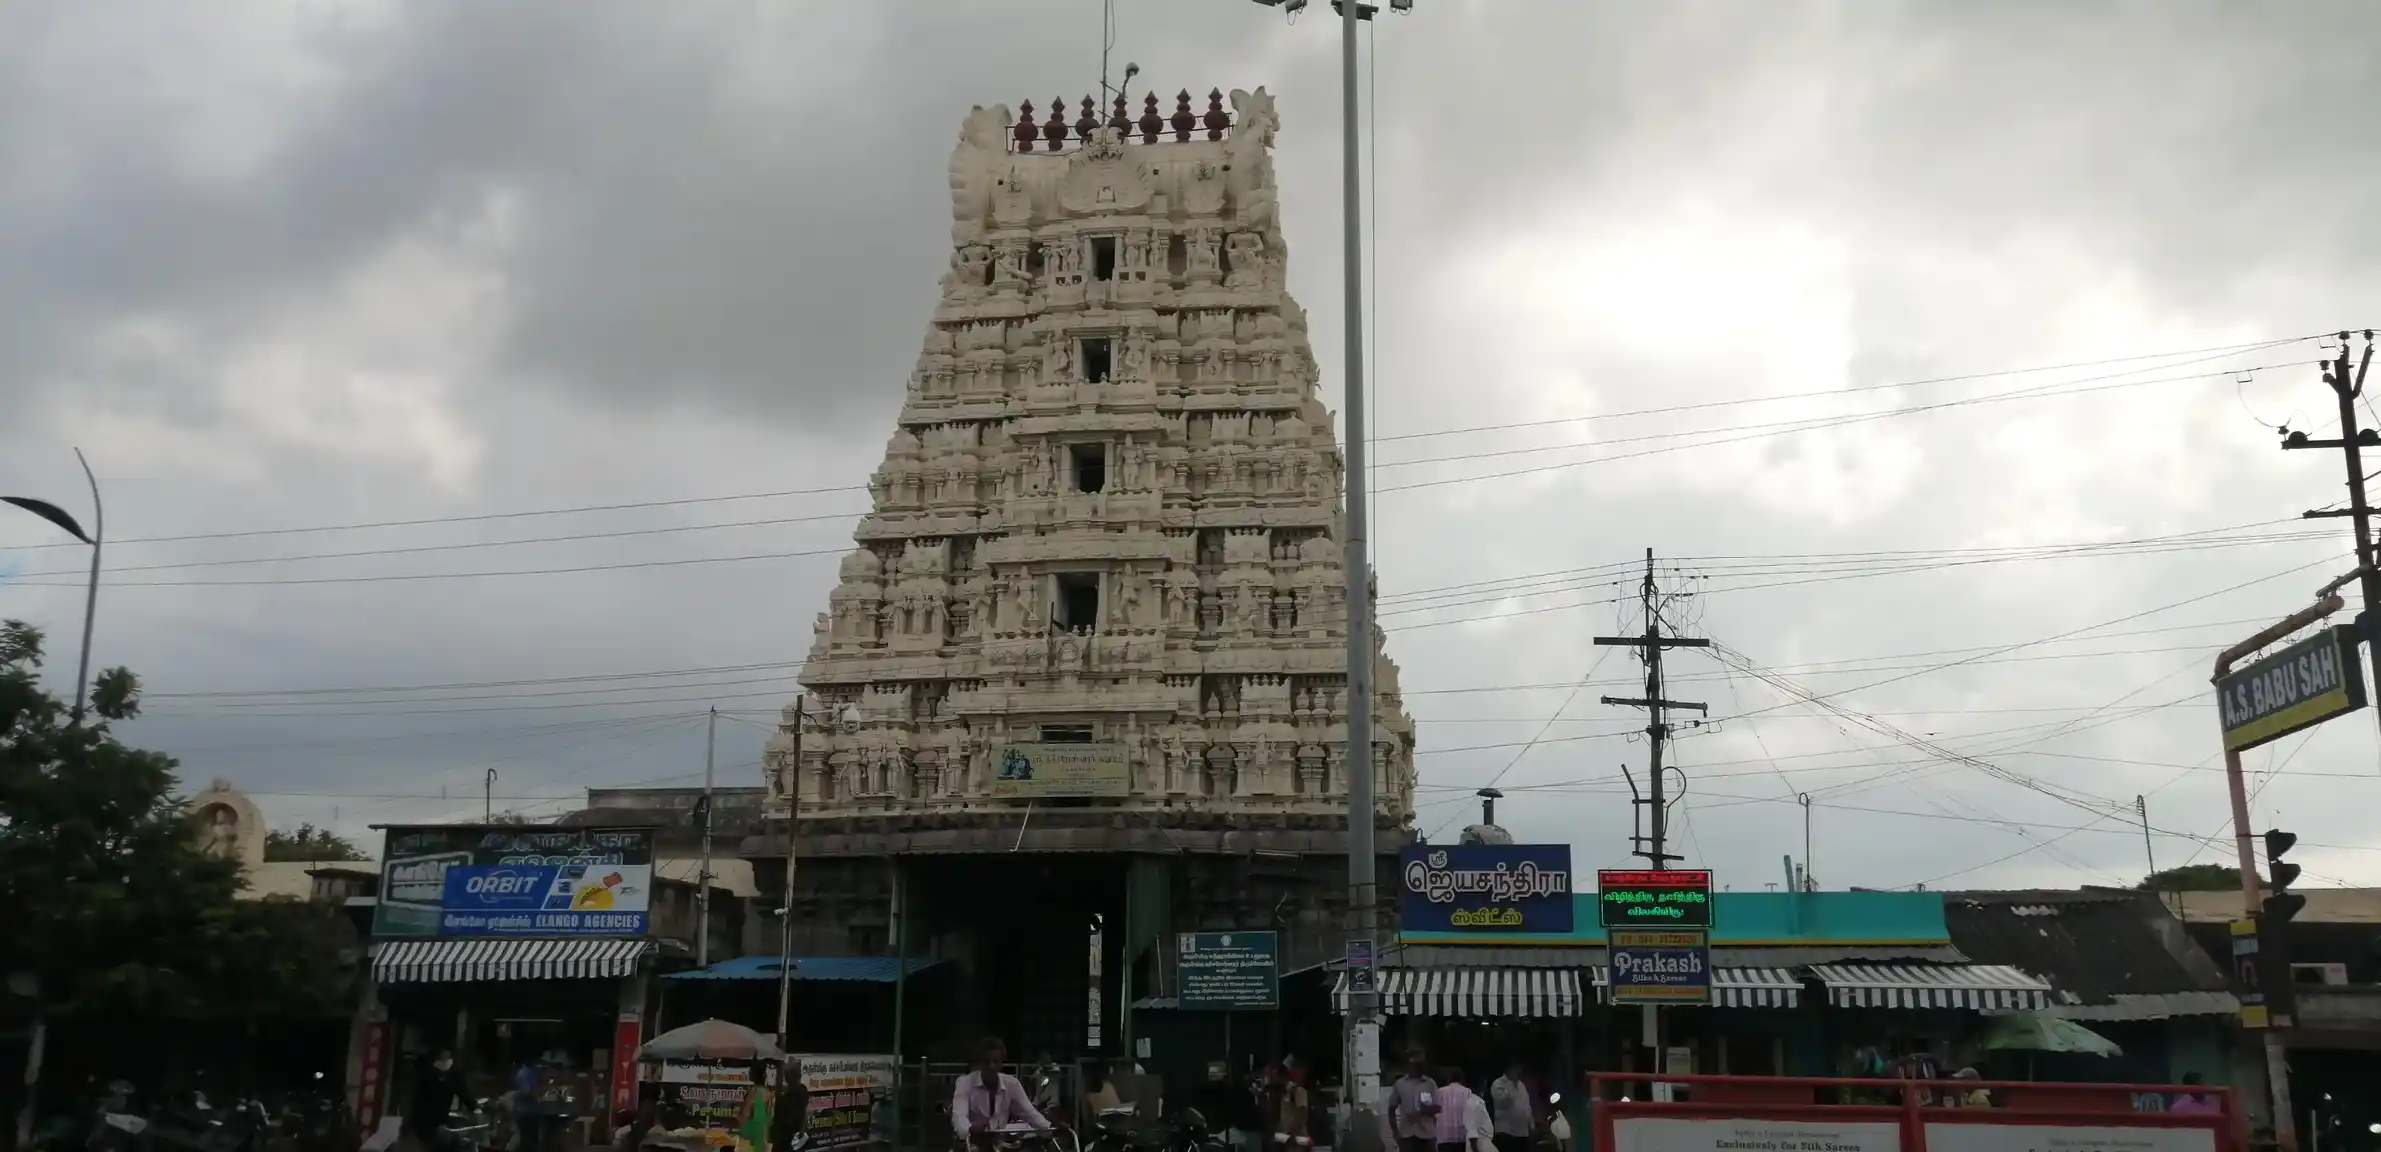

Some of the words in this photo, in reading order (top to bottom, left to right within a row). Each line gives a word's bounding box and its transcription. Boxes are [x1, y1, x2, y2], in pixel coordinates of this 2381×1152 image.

[2225, 684, 2252, 727] A.S.
[2253, 662, 2297, 715] BABU
[2299, 645, 2336, 697] SAH
[466, 876, 539, 894] ORBIT
[1405, 860, 1567, 902] ஜெயசந்திரா
[536, 915, 579, 928] ELANGO
[584, 915, 641, 928] AGENCIES
[1451, 907, 1523, 926] ஸ்வீட்ஸ்
[1614, 952, 1702, 977] Prakash
[1716, 1140, 1777, 1152] Exclusively
[1780, 1141, 1797, 1150] for
[1801, 1140, 1822, 1151] Silk
[1826, 1142, 1860, 1152] Sarees
